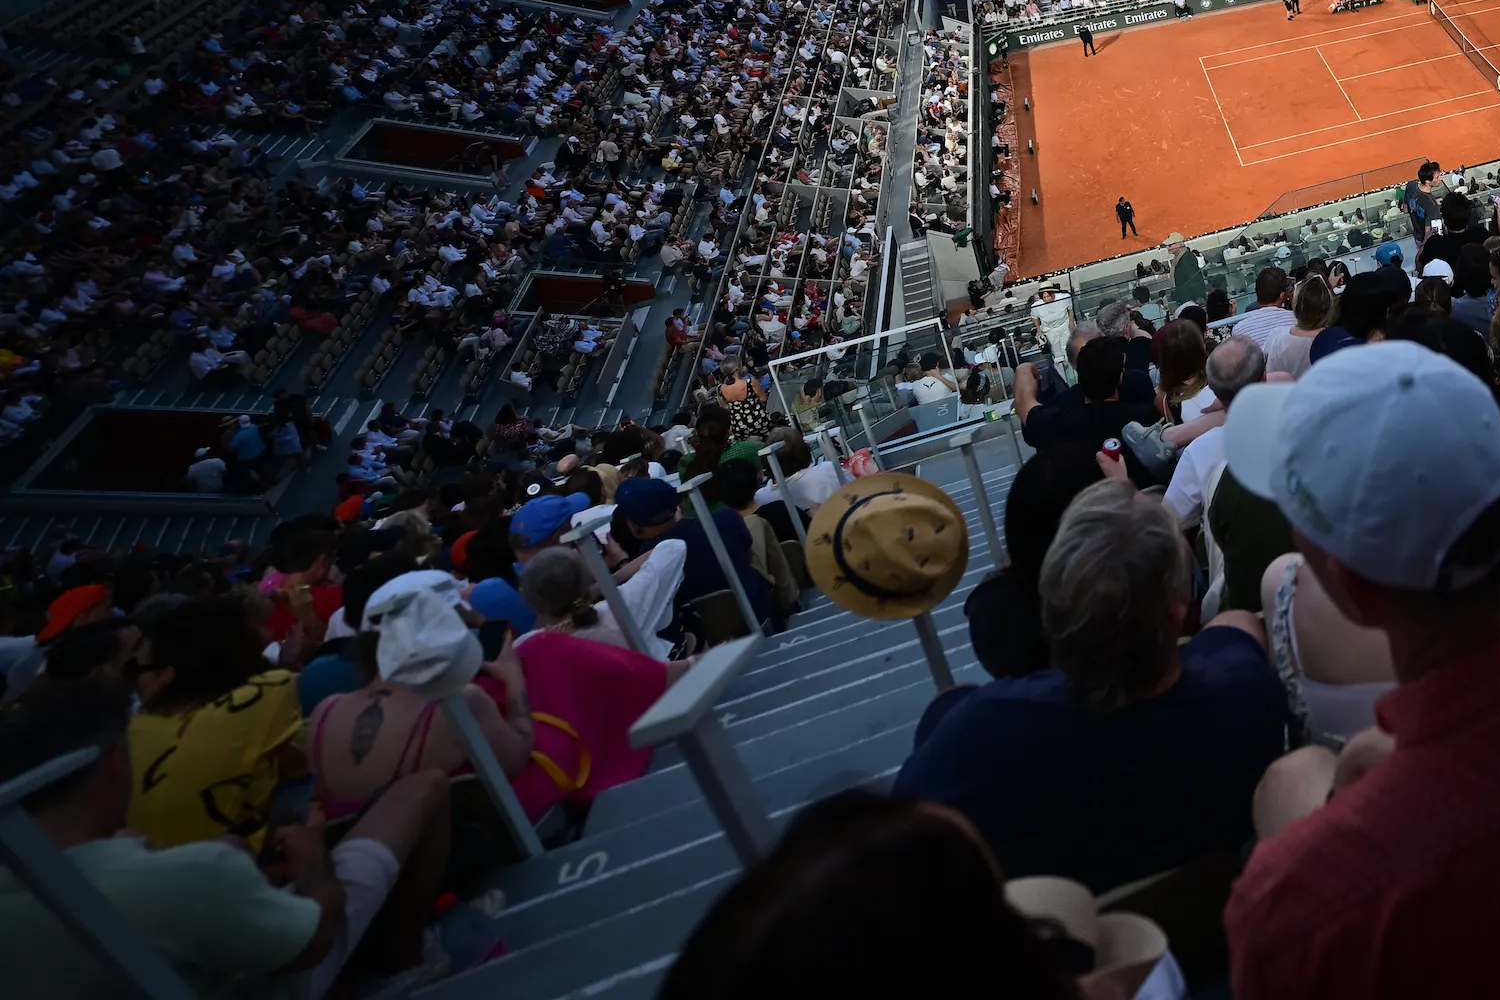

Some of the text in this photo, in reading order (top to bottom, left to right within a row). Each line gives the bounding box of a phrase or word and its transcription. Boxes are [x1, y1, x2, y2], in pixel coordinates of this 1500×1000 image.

[1124, 8, 1168, 25] Emirates
[1019, 28, 1064, 45] Emirates
[557, 851, 609, 886] 5
